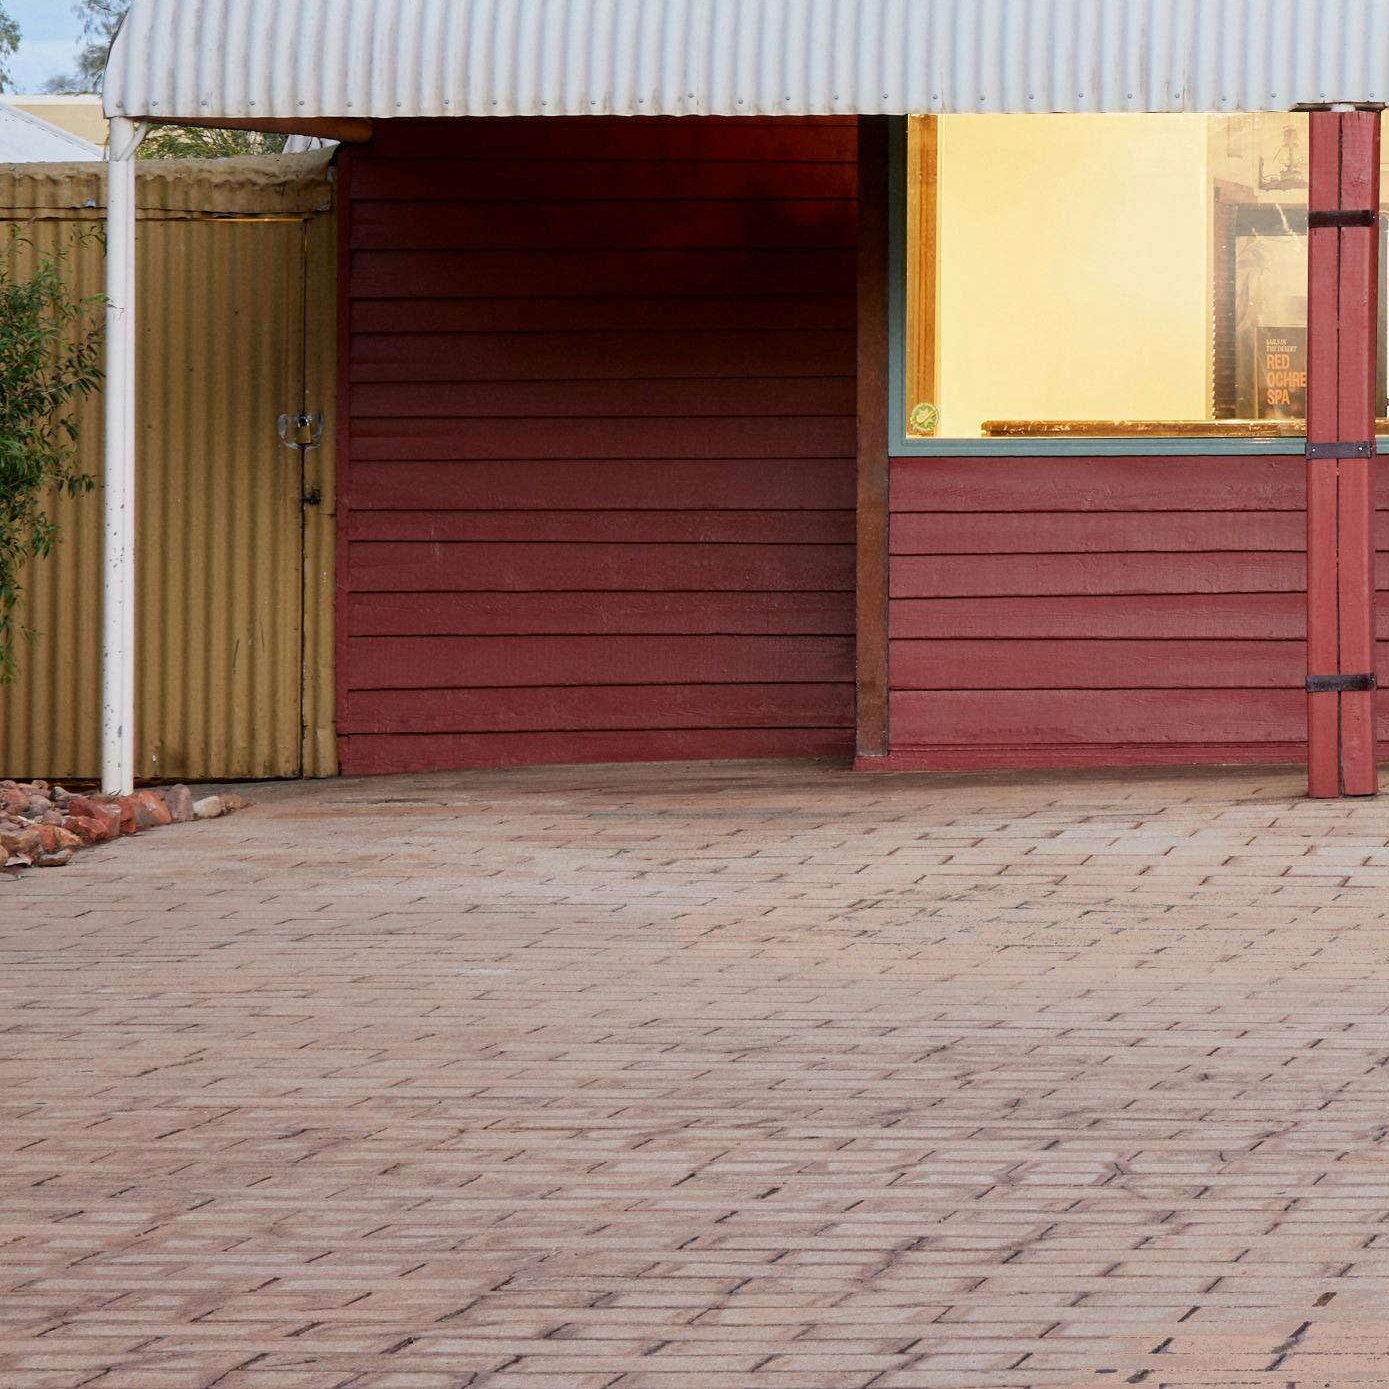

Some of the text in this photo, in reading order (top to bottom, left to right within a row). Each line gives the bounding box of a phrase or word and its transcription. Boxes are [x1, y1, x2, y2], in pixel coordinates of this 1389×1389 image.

[1266, 354, 1290, 370] RED
[1266, 371, 1306, 387] OCHRE
[1267, 389, 1290, 405] SPA
